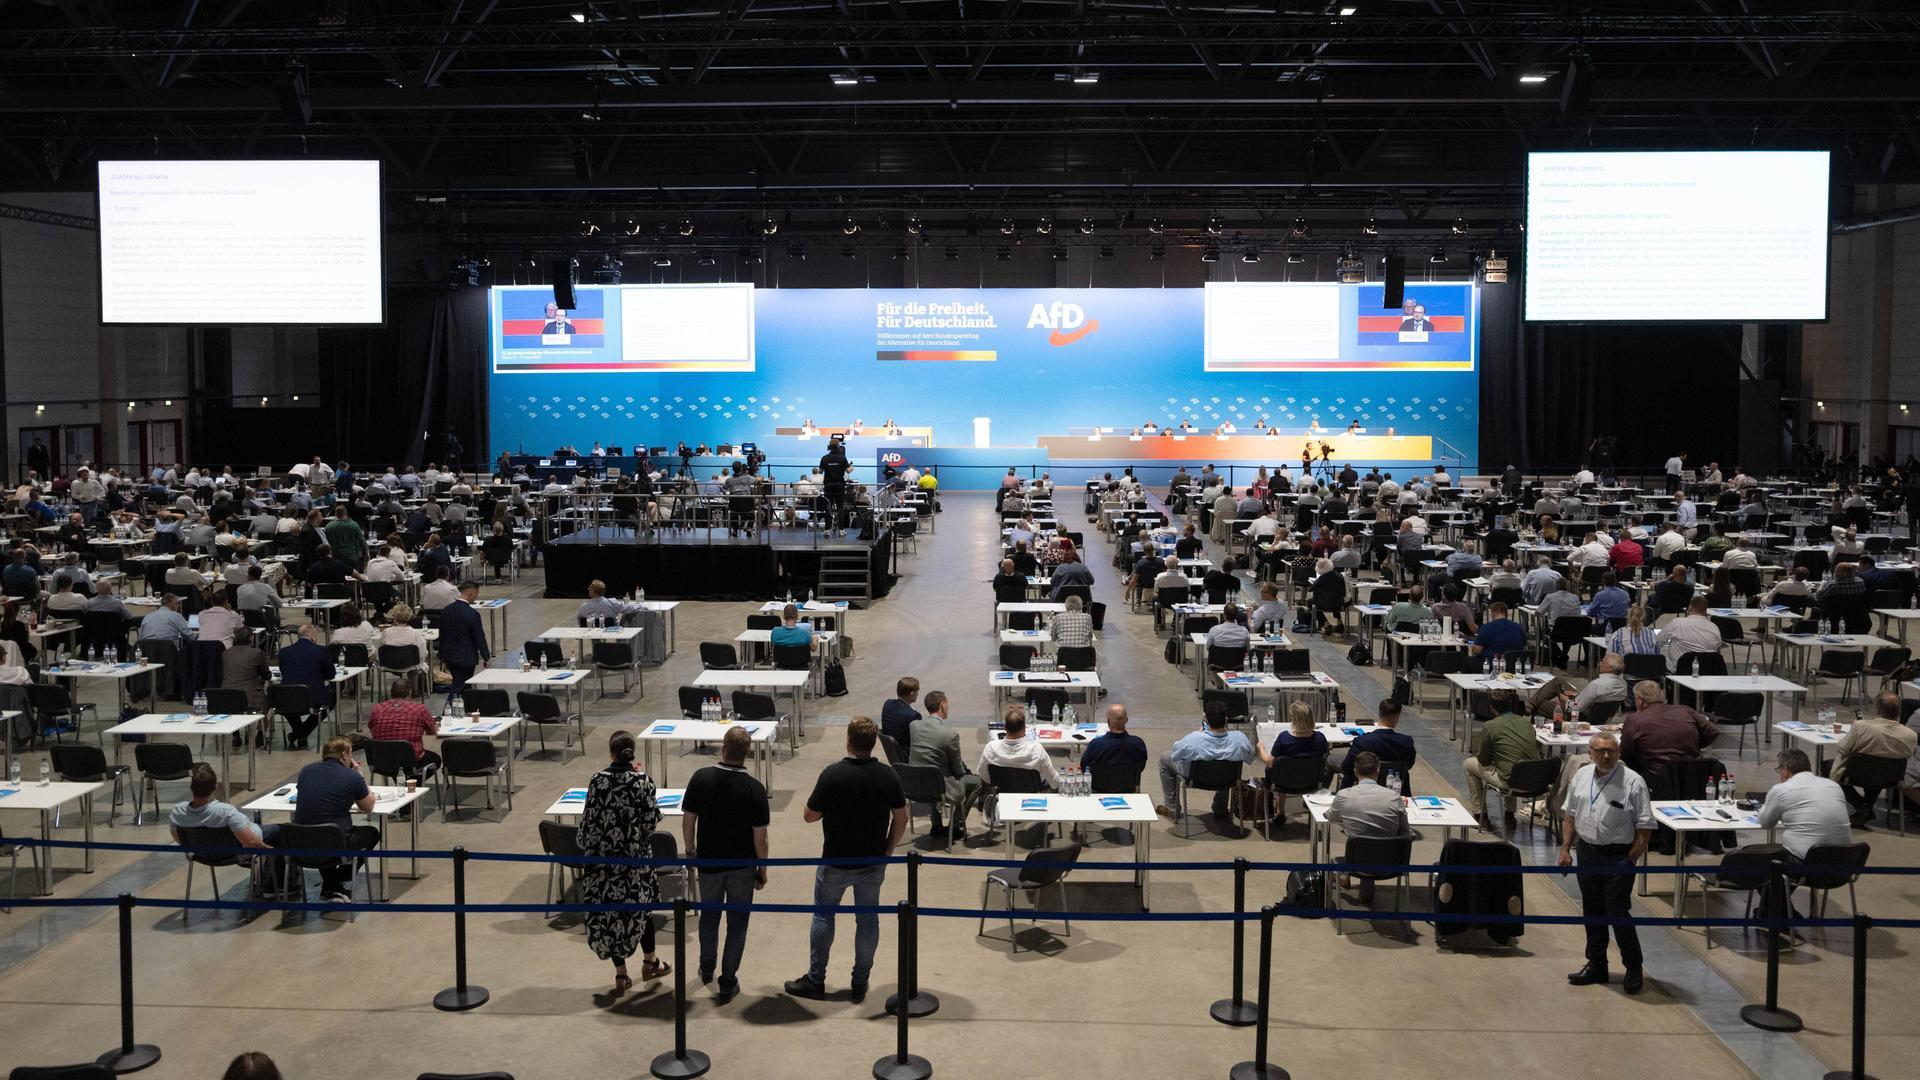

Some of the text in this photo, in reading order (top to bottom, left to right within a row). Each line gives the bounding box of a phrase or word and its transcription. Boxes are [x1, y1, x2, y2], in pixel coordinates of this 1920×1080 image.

[877, 302, 989, 315] Für die Freiheit.
[1026, 301, 1085, 329] AfD
[877, 315, 997, 328] Für Deutschland.
[881, 453, 901, 462] AfD
